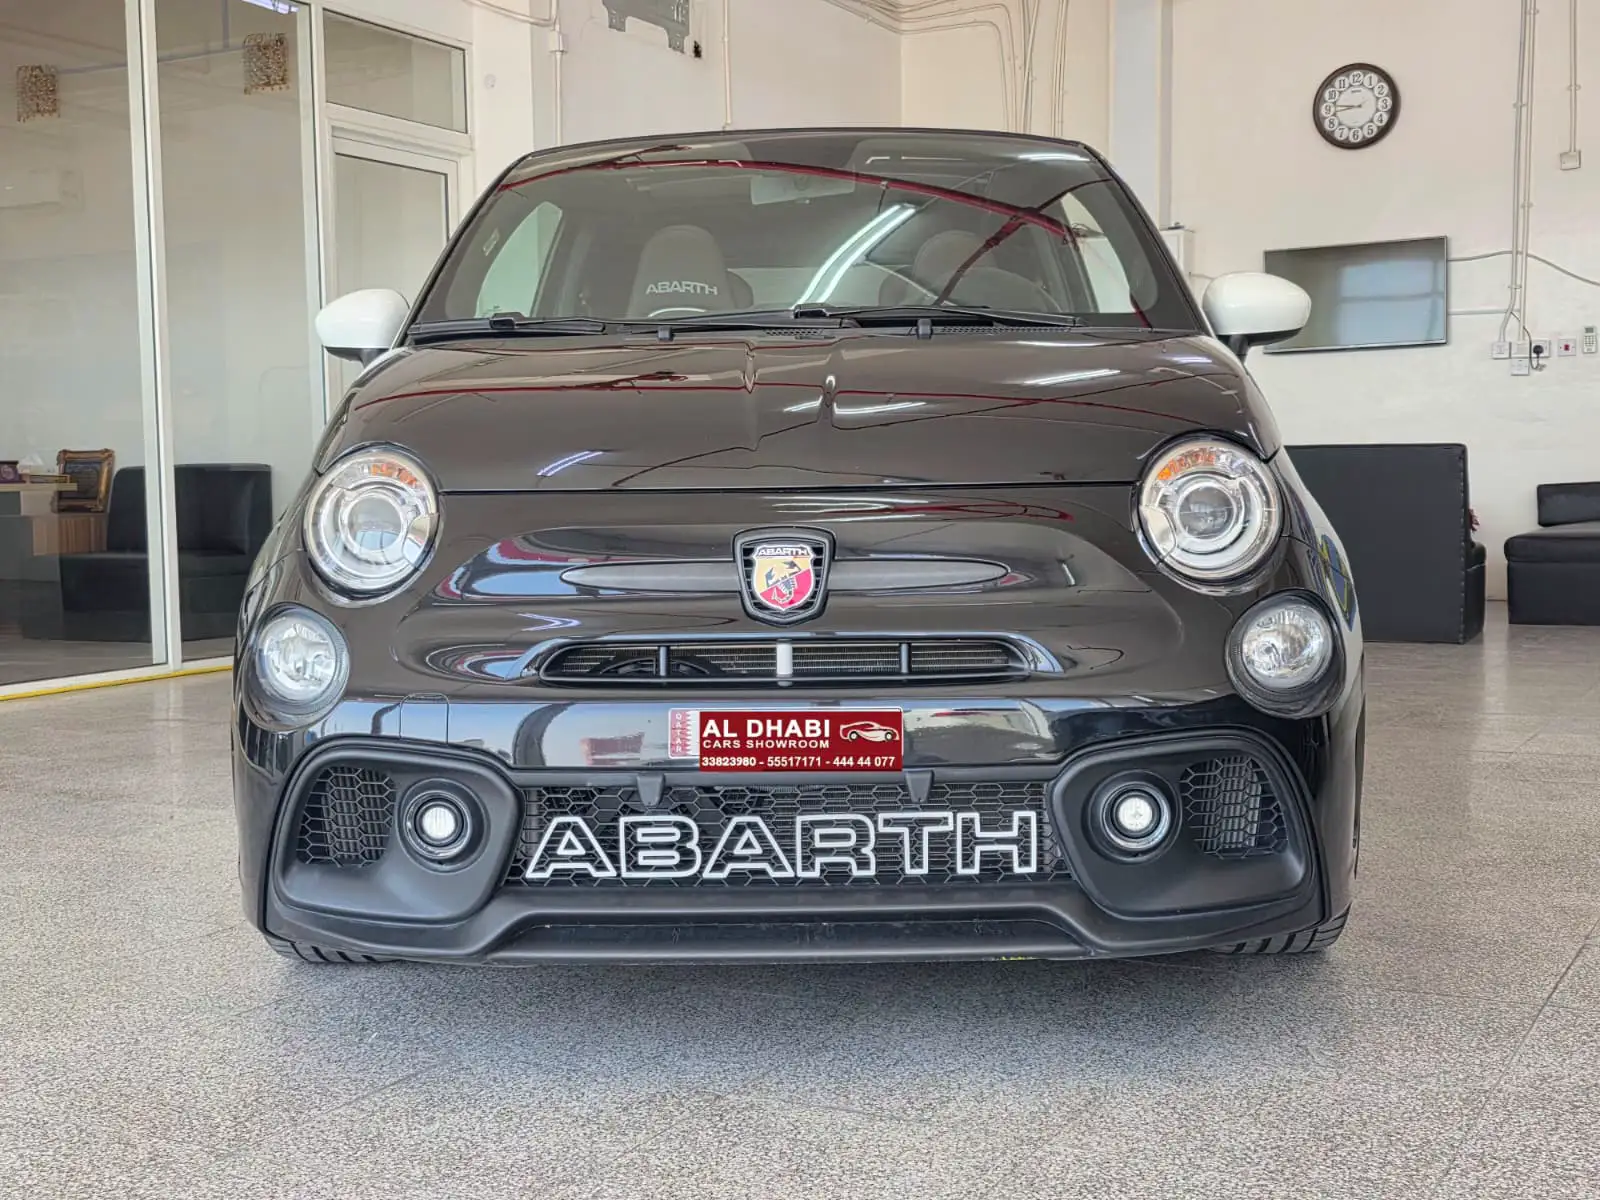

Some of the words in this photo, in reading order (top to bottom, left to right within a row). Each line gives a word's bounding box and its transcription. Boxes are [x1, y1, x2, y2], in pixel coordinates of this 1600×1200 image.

[1352, 72, 1362, 84] 12
[1368, 75, 1373, 87] 1
[1338, 79, 1346, 89] 11
[1327, 90, 1337, 101] 10
[1377, 85, 1384, 96] 2
[1324, 104, 1332, 115] 9
[1381, 99, 1388, 109] 3
[1328, 119, 1336, 129] 8
[1377, 114, 1384, 124] 4
[1338, 127, 1345, 138] 7
[1352, 130, 1360, 141] 6
[1366, 125, 1374, 136] 5
[645, 280, 718, 296] ABARTH
[758, 547, 807, 556] ABARTH
[525, 810, 1038, 879] ABARTH
